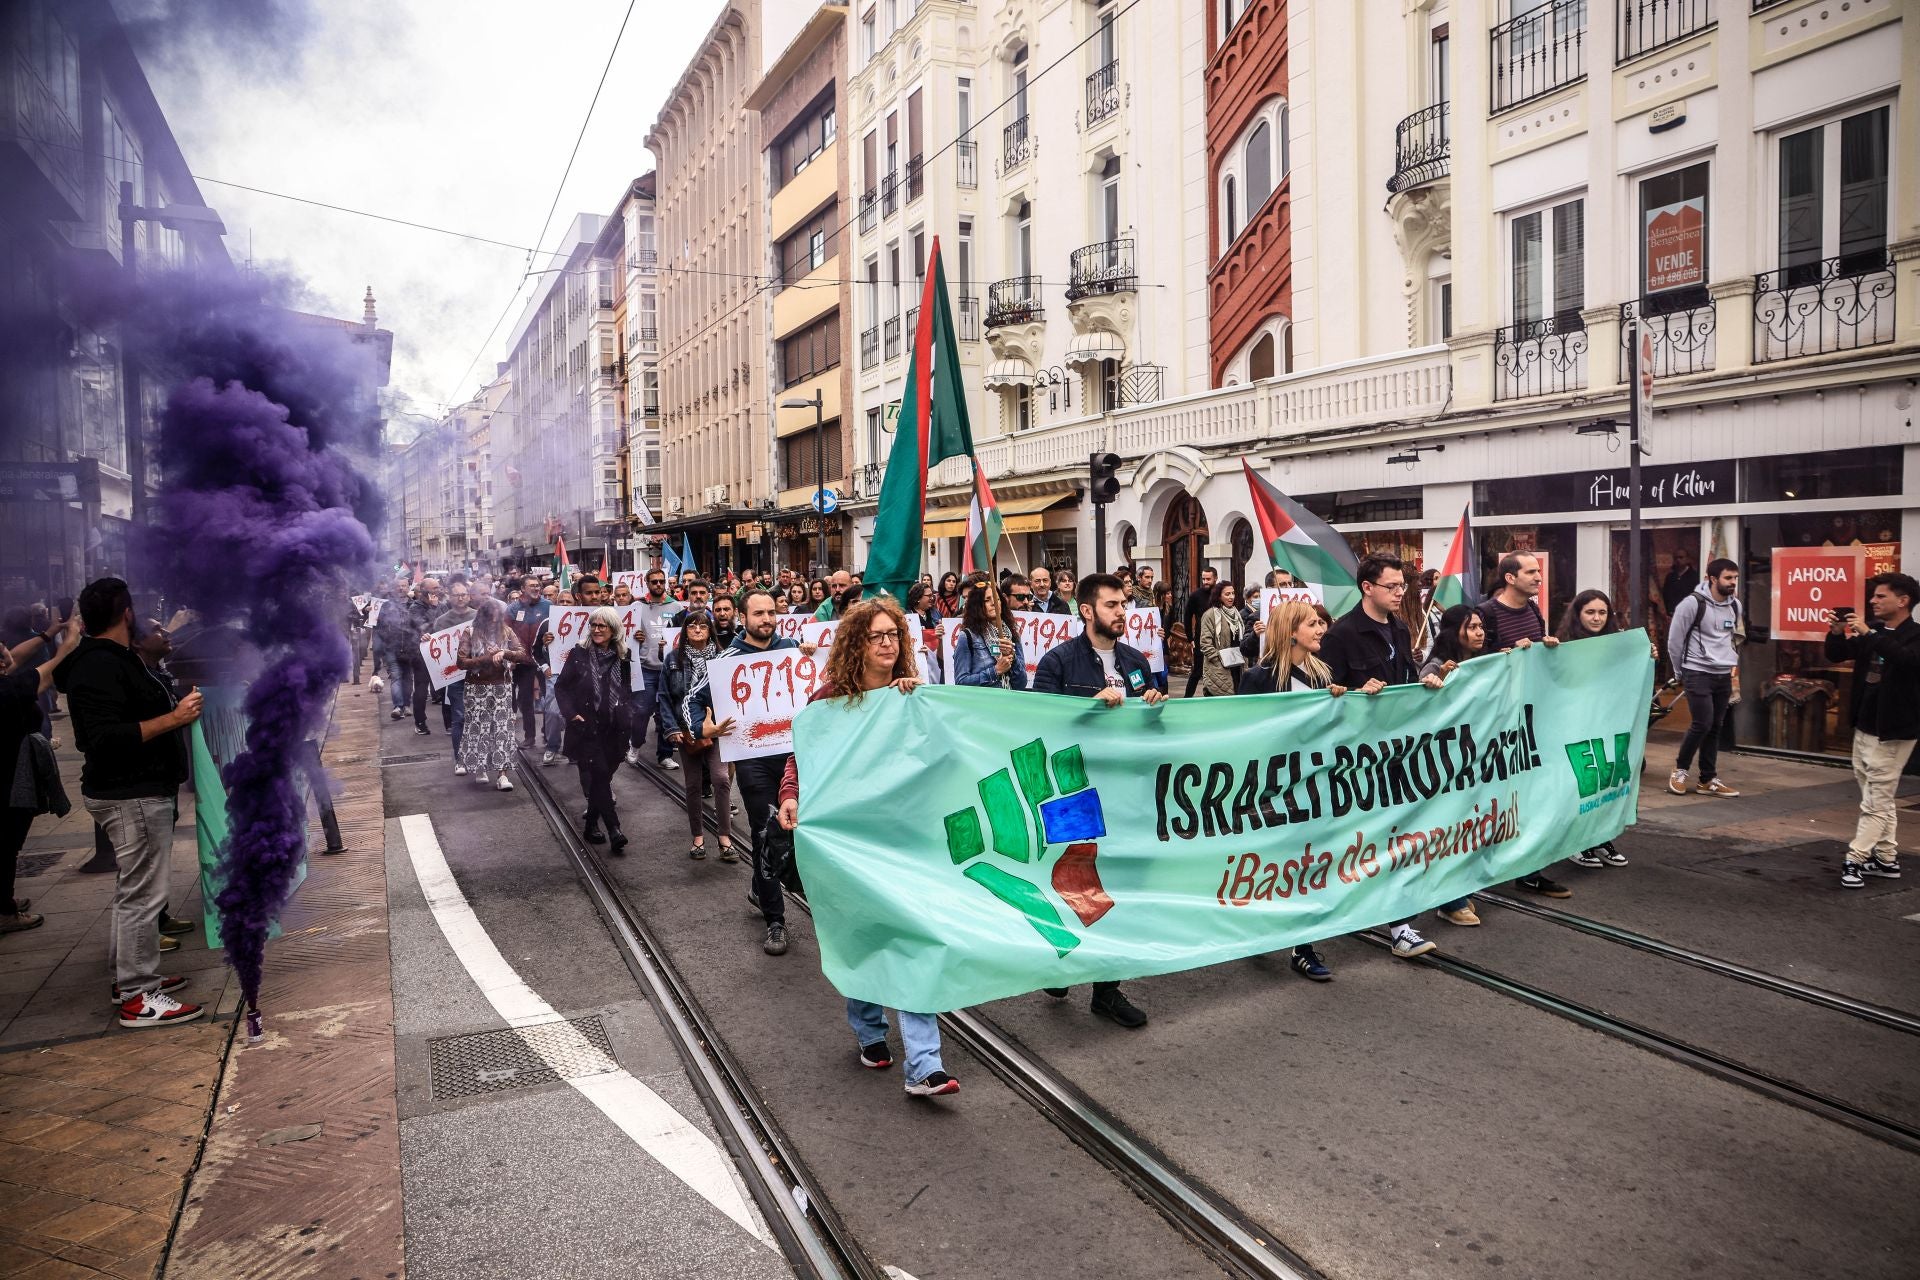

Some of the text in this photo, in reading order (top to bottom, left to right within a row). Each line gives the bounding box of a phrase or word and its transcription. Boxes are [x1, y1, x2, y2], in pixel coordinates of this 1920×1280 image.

[1651, 230, 1700, 248] Bengochea
[1656, 250, 1694, 273] VENDE
[1652, 479, 1665, 503] of
[1672, 469, 1715, 498] Kilim
[1787, 567, 1847, 585] ¡AHORA
[1810, 587, 1822, 602] O
[1787, 607, 1834, 623] NUNC
[1328, 723, 1477, 818] BOIKOTA
[1565, 732, 1632, 799] ELA
[1216, 790, 1521, 907] ¡Basta de impunidad!
